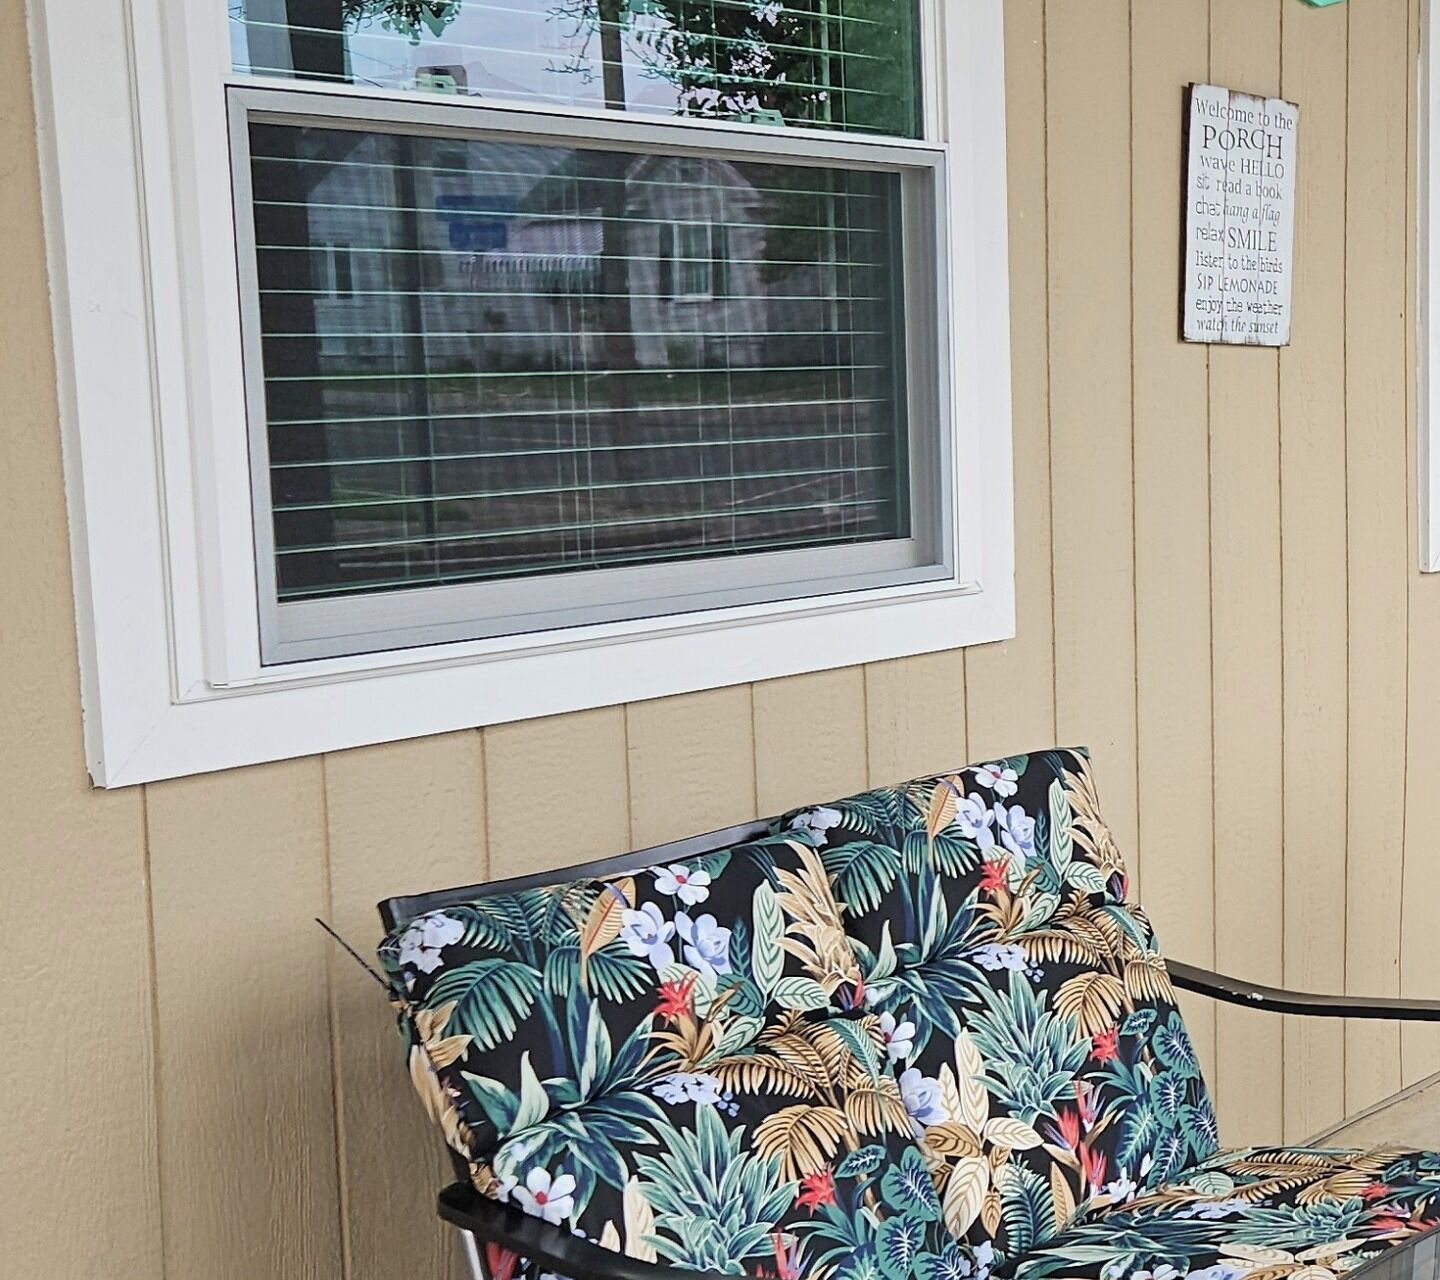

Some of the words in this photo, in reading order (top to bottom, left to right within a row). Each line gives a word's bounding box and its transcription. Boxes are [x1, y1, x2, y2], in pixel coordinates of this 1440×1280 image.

[1196, 98, 1254, 124] Welcome
[1258, 112, 1270, 126] to
[1274, 112, 1293, 130] the
[1202, 125, 1282, 159] PORCH
[1200, 155, 1236, 172] wave
[1241, 158, 1285, 179] HELLO
[1216, 178, 1241, 195] read
[1245, 183, 1252, 196] a
[1256, 180, 1282, 200] book
[1223, 199, 1249, 224] hang
[1252, 207, 1259, 220] a
[1260, 204, 1280, 227] flag
[1196, 221, 1224, 242] relax
[1228, 227, 1278, 252] SMILE
[1228, 253, 1239, 270] to
[1241, 255, 1257, 271] the
[1259, 257, 1283, 273] birds
[1197, 273, 1214, 290] SIP
[1218, 274, 1278, 295] LEMONADE
[1195, 296, 1223, 314] enjoy
[1226, 297, 1243, 312] the
[1197, 315, 1228, 332] watch
[1231, 316, 1247, 333] the
[1248, 321, 1278, 334] sunset
